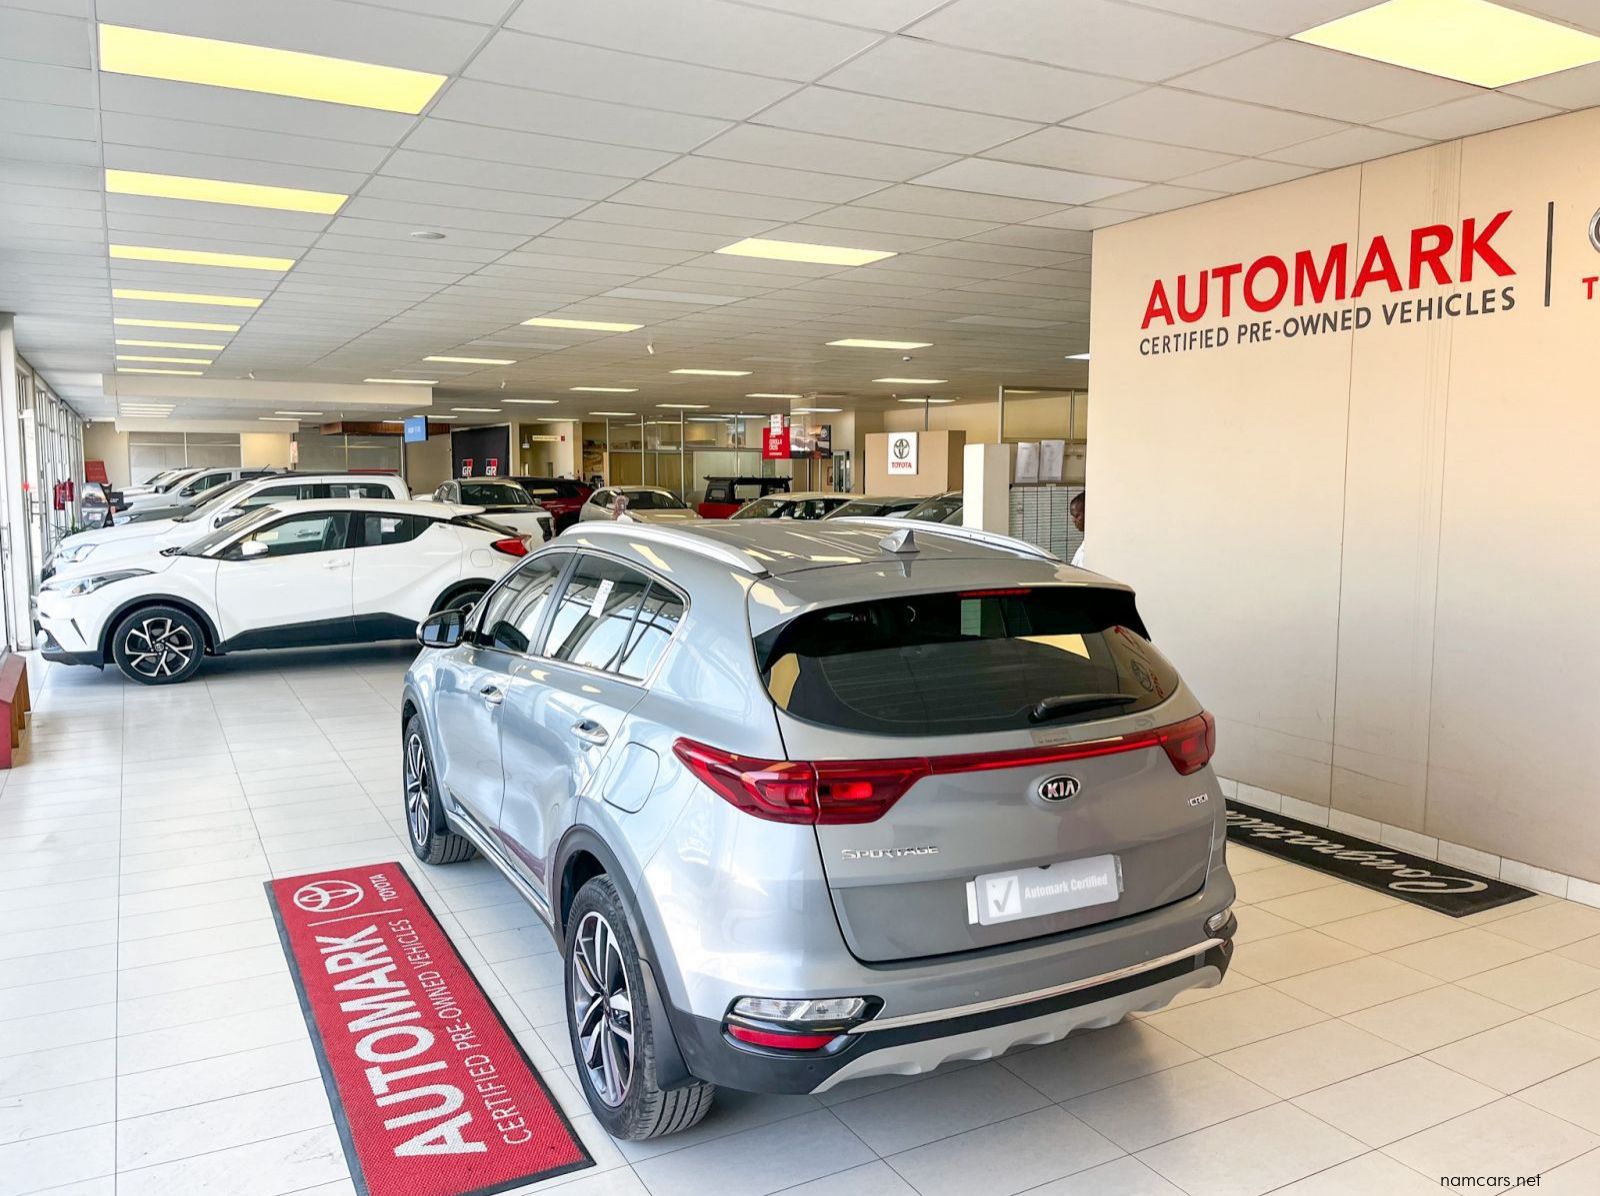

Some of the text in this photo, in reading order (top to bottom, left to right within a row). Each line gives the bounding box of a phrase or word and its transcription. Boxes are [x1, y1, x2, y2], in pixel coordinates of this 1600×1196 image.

[1140, 209, 1516, 330] AUTOMARK
[1139, 286, 1516, 356] CERTIFIED PRE-OWNED VEHICLES
[462, 466, 472, 477] GR
[485, 466, 497, 476] GR
[891, 461, 912, 469] TOYOTA
[1047, 781, 1076, 798] KIA
[841, 845, 939, 860] SPORTAGE
[369, 873, 399, 902] TOYOTA
[1024, 873, 1108, 899] Automark Certified
[315, 924, 488, 1158] AUTOMARK
[388, 919, 533, 1145] CERTIFIED PRE-OWNED VEHICLES
